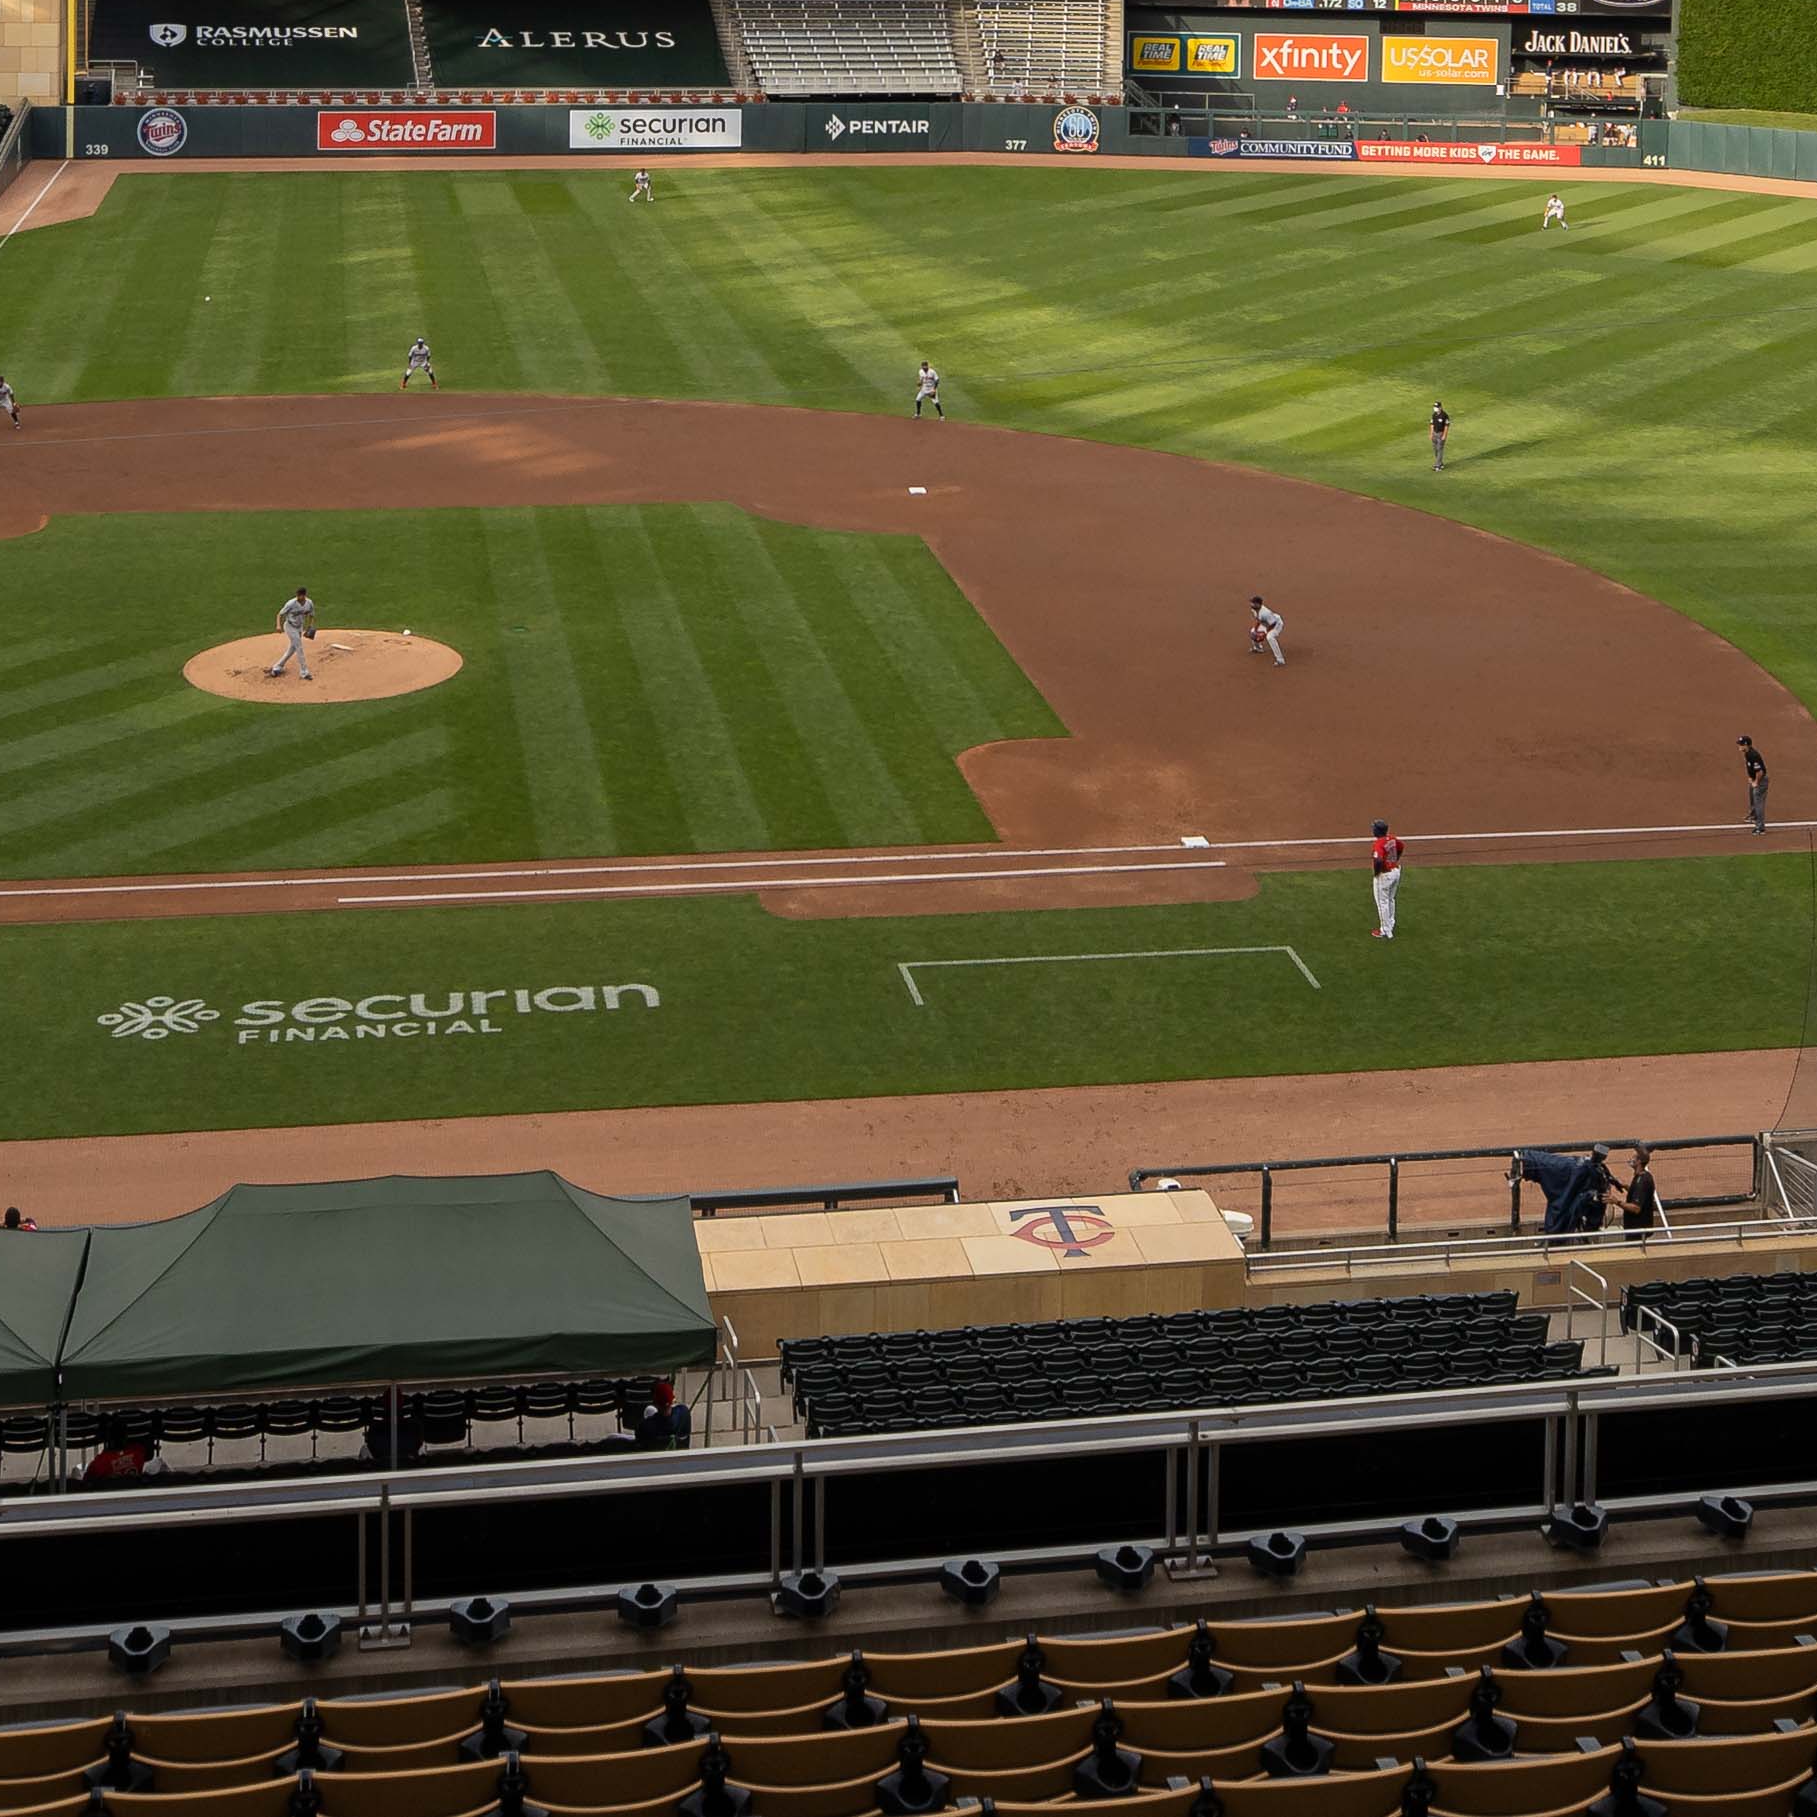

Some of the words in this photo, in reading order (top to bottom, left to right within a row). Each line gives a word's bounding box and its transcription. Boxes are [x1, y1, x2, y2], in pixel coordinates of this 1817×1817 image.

[197, 25, 357, 40] RASMUSSEN
[477, 28, 675, 48] ALERUS
[197, 38, 293, 46] COLLEGE
[1525, 30, 1565, 52] JACK
[1261, 40, 1362, 76] xfinity
[620, 114, 726, 134] securian
[849, 119, 929, 134] PENTAIR
[620, 136, 683, 147] FINANCIAL
[1005, 139, 1027, 151] 377
[1241, 142, 1317, 154] COMMUNITY
[1318, 143, 1352, 155] FUND
[85, 145, 108, 154] 339
[1362, 145, 1410, 157] GETTING
[1413, 147, 1446, 158] MORE
[1450, 148, 1476, 158] KIDS
[1498, 149, 1520, 159] THE
[1523, 150, 1559, 160] GAME.
[1644, 155, 1665, 166] 411
[235, 982, 661, 1027] securian
[239, 1018, 502, 1045] FINANCIAL
